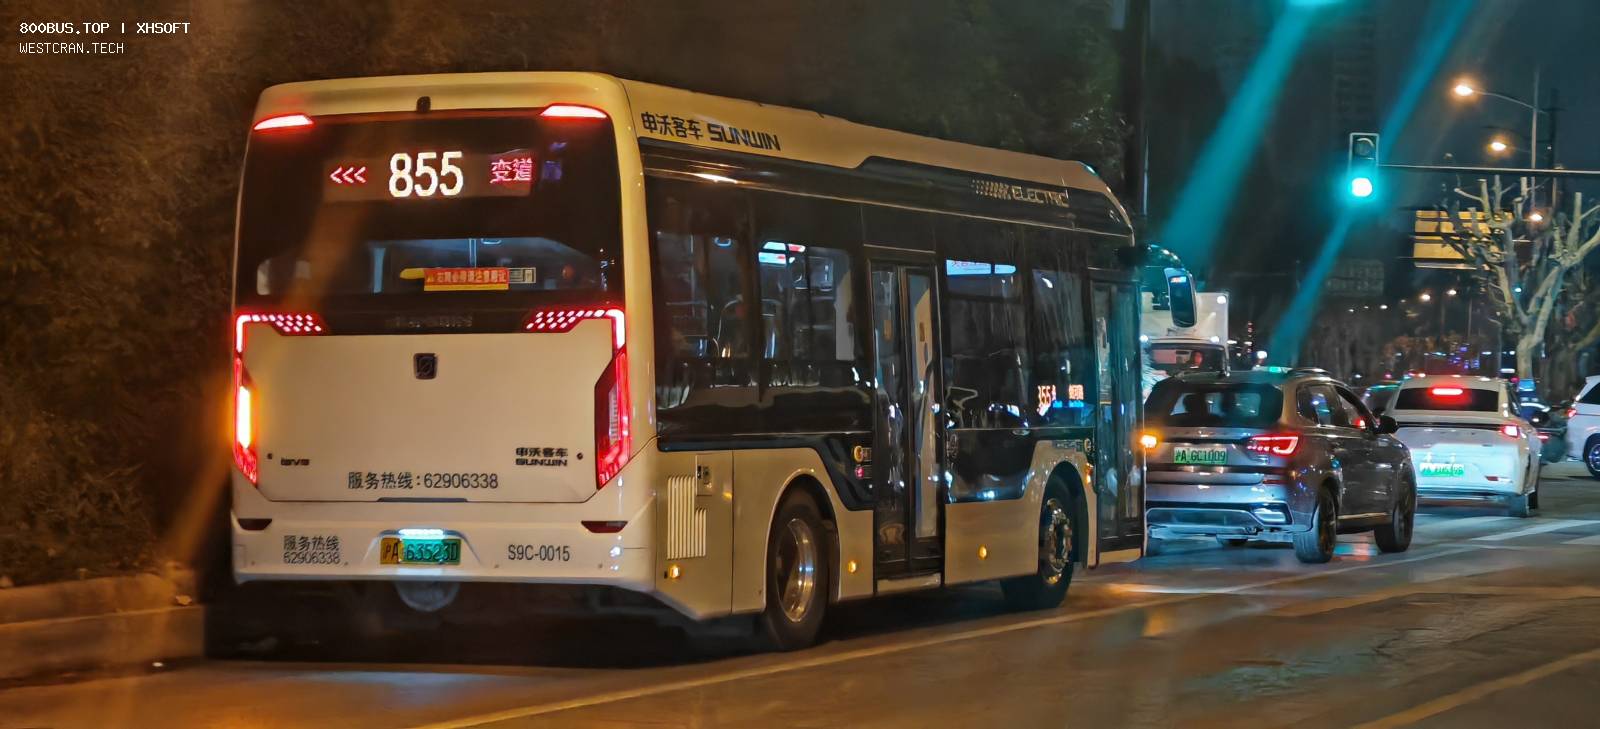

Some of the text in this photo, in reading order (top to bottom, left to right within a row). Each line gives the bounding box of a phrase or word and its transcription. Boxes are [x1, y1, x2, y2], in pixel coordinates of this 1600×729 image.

[640, 111, 782, 151] 申沃客车 SUNWIN
[388, 150, 464, 198] 855
[489, 157, 534, 184] 变道
[515, 447, 568, 458] 申沃客车
[515, 458, 568, 467] SUNWIN
[283, 534, 340, 551] 服务热线
[283, 551, 341, 565] 62906338
[507, 544, 570, 561] S9C-0015
